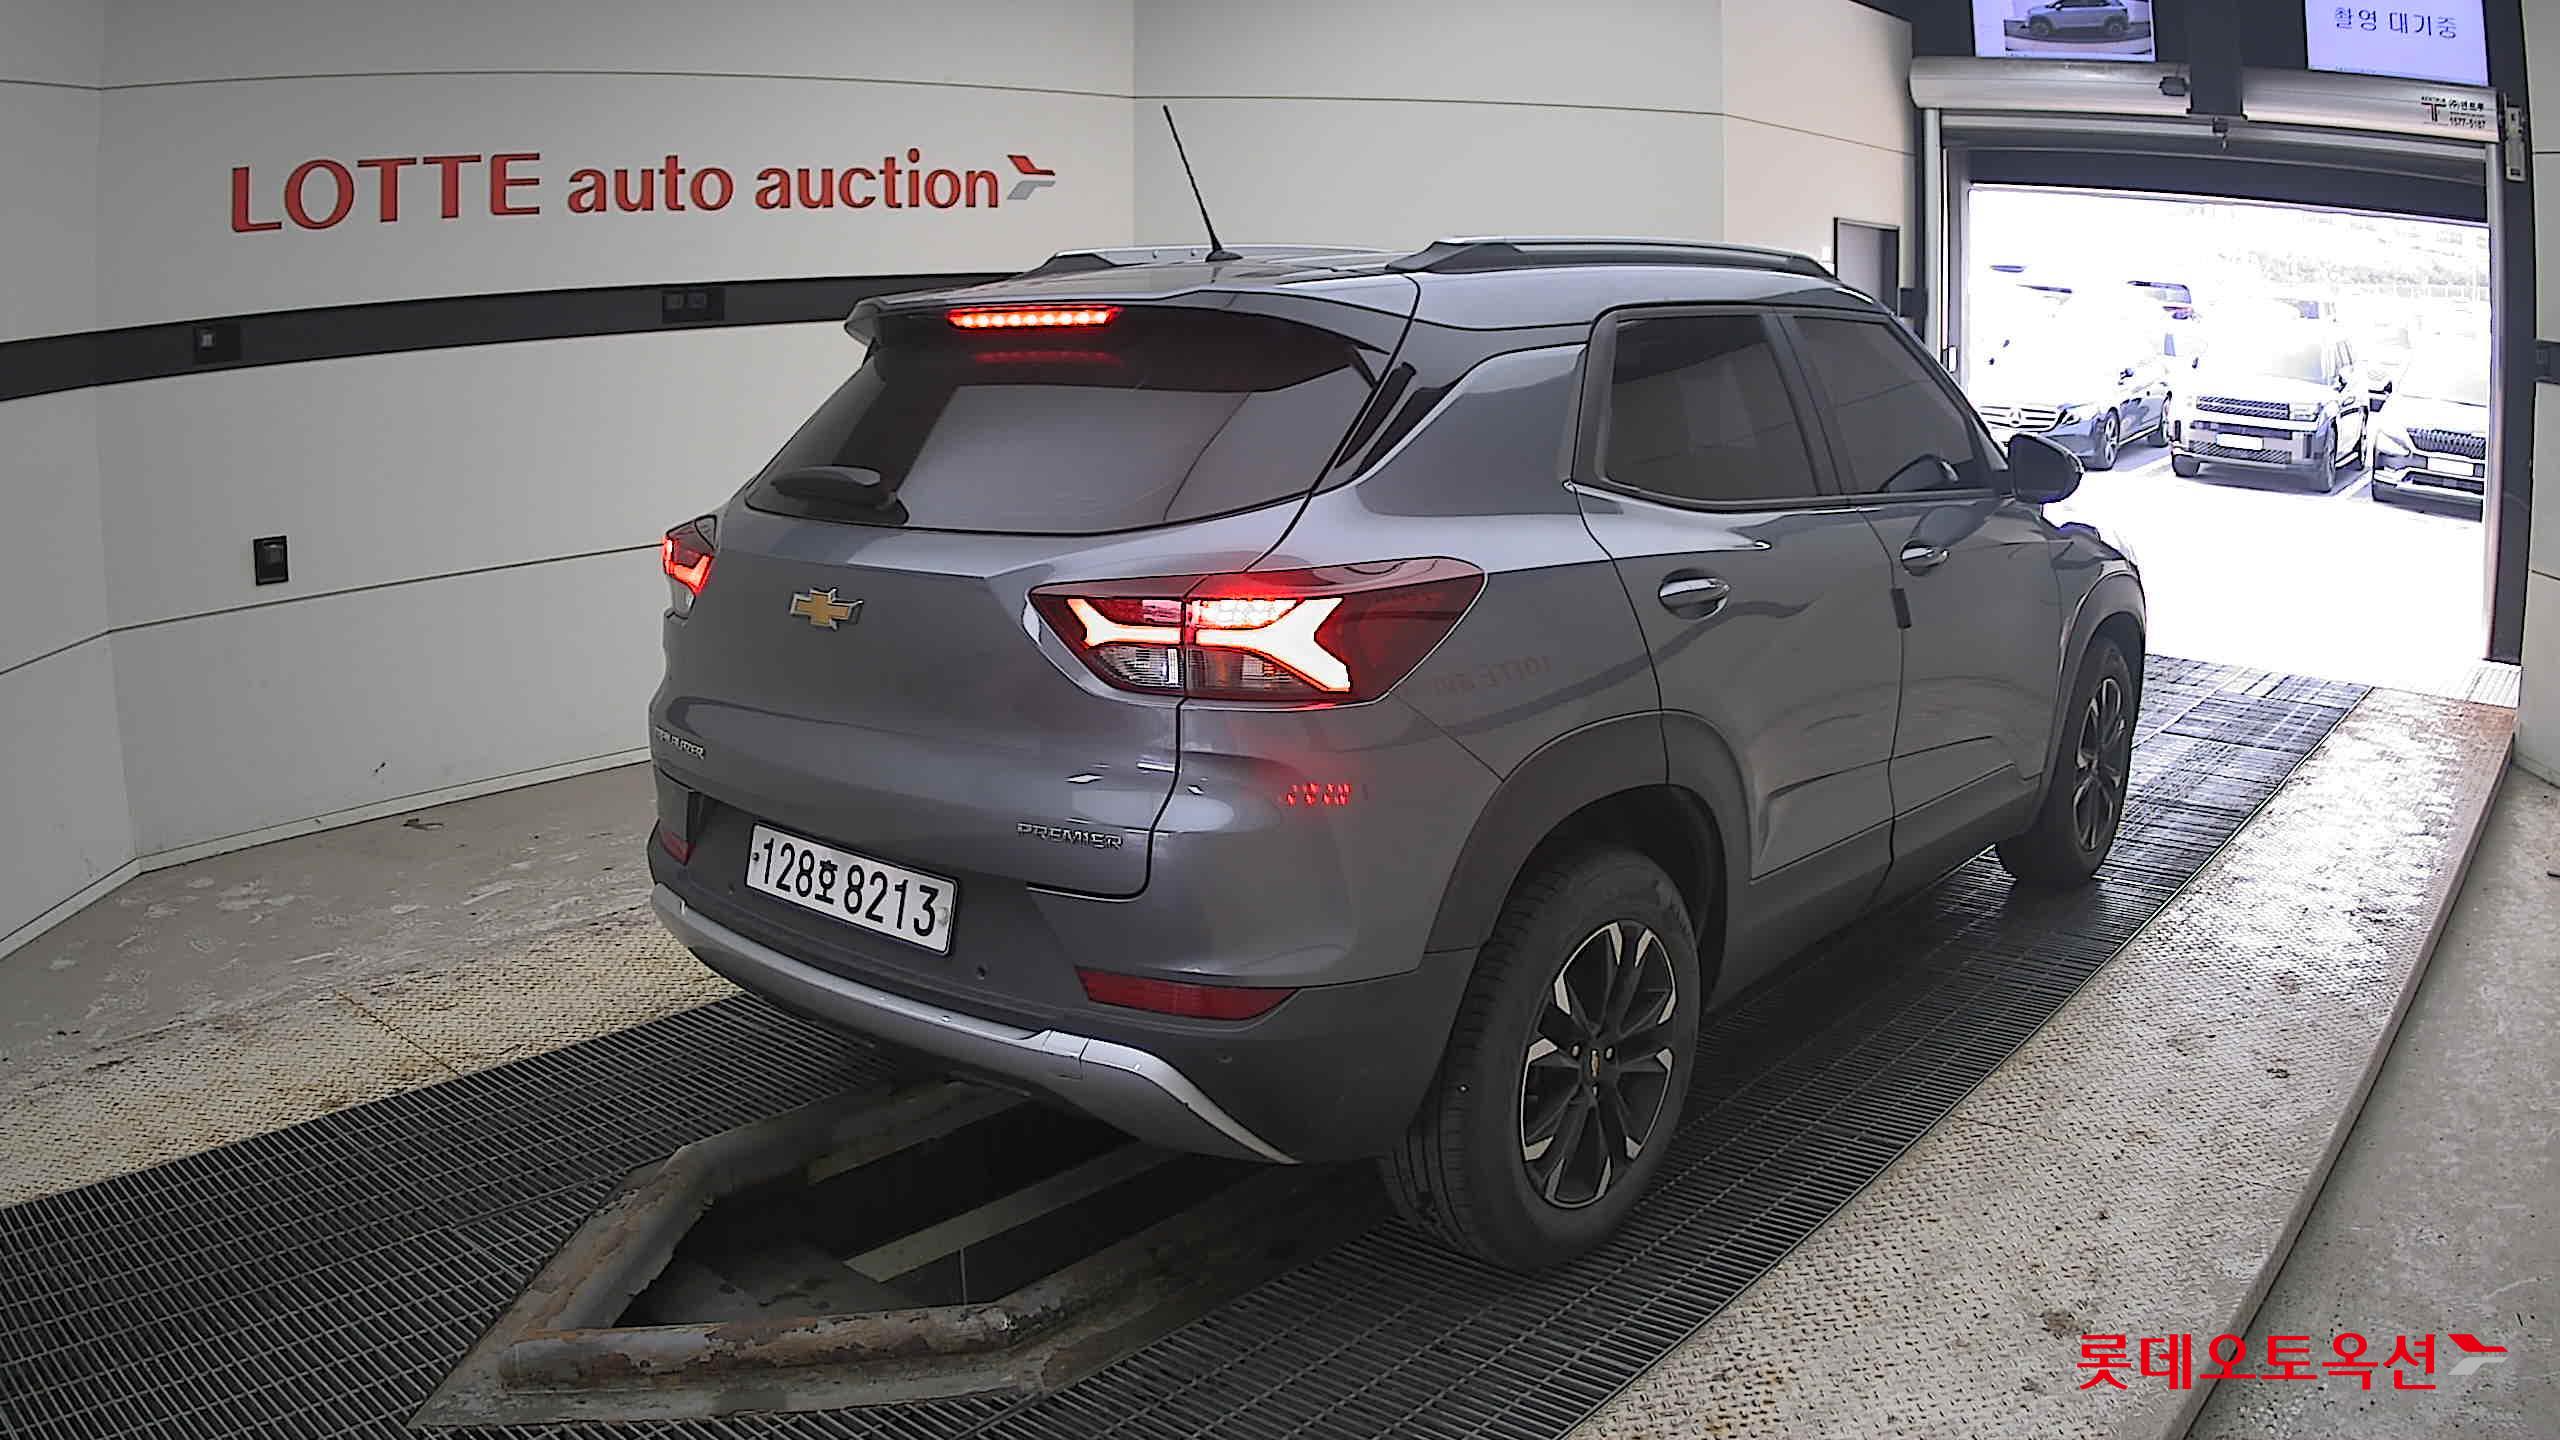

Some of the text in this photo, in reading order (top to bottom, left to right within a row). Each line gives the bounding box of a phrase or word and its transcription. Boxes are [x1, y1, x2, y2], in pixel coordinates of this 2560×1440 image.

[2335, 7, 2457, 39] 촬영 대기중
[231, 147, 1000, 233] LOTTE auto auction
[1016, 821, 1124, 850] PREMIER
[763, 838, 940, 937] 128호8213
